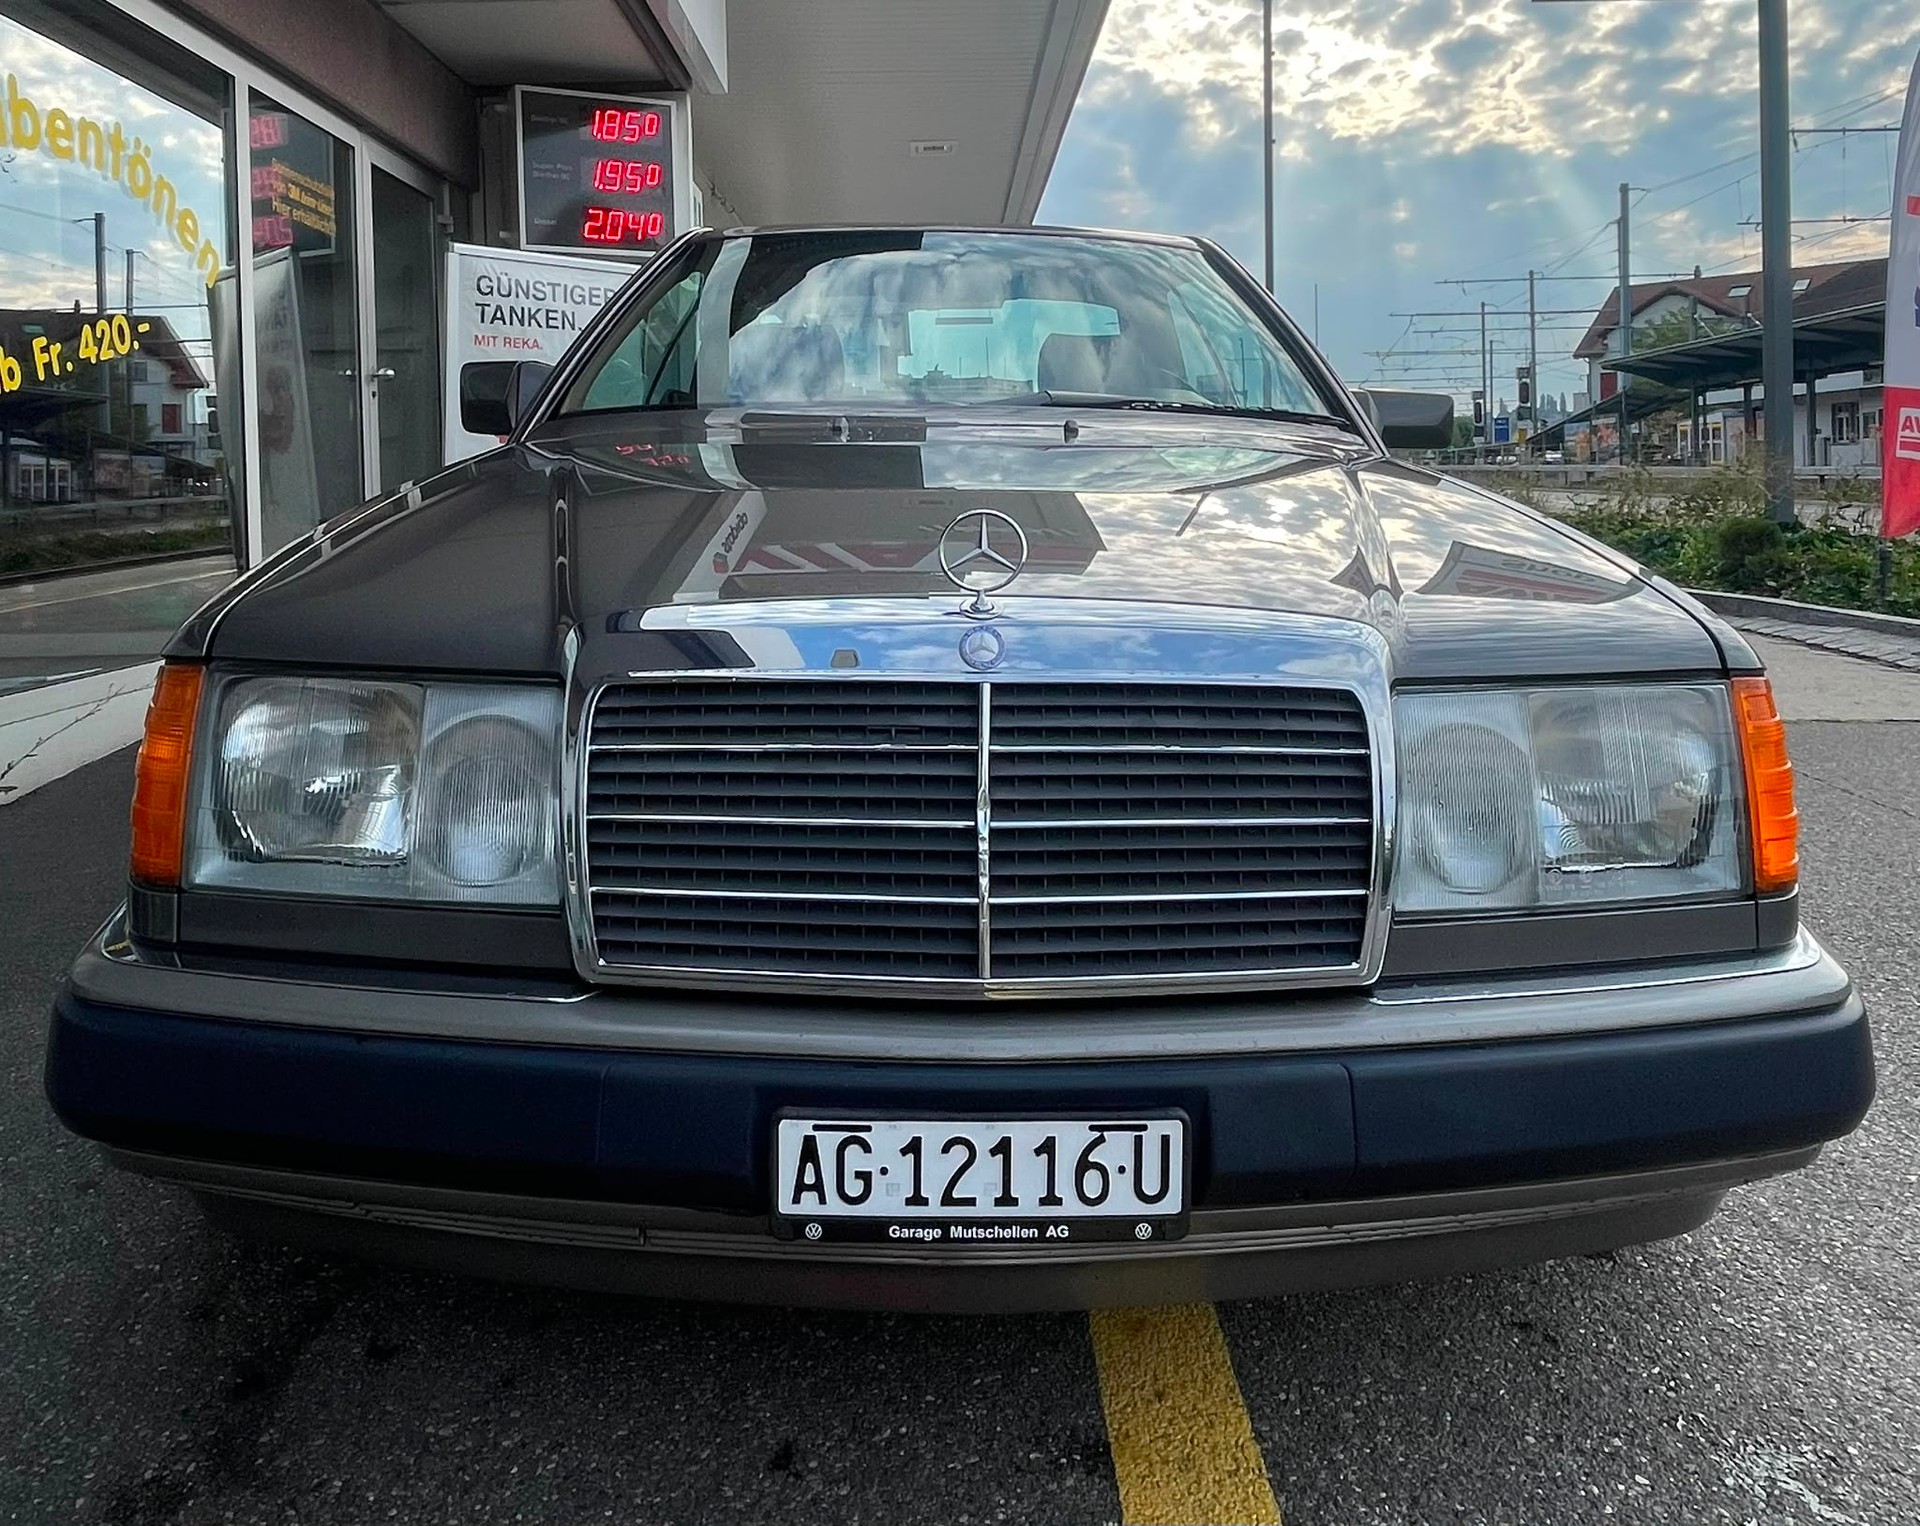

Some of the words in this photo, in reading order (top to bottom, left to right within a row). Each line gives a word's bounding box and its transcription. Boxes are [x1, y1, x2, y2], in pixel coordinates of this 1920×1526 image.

[584, 208, 661, 241] 2.040
[475, 302, 582, 331] TANKEN.
[0, 344, 21, 393] b
[32, 336, 74, 381] Fr.
[79, 314, 150, 364] 420.-
[473, 334, 497, 347] MIT
[503, 337, 543, 350] REKA.
[889, 1225, 942, 1241] Garage
[950, 1225, 1038, 1240] Mutschellen
[1046, 1225, 1070, 1239] AG
